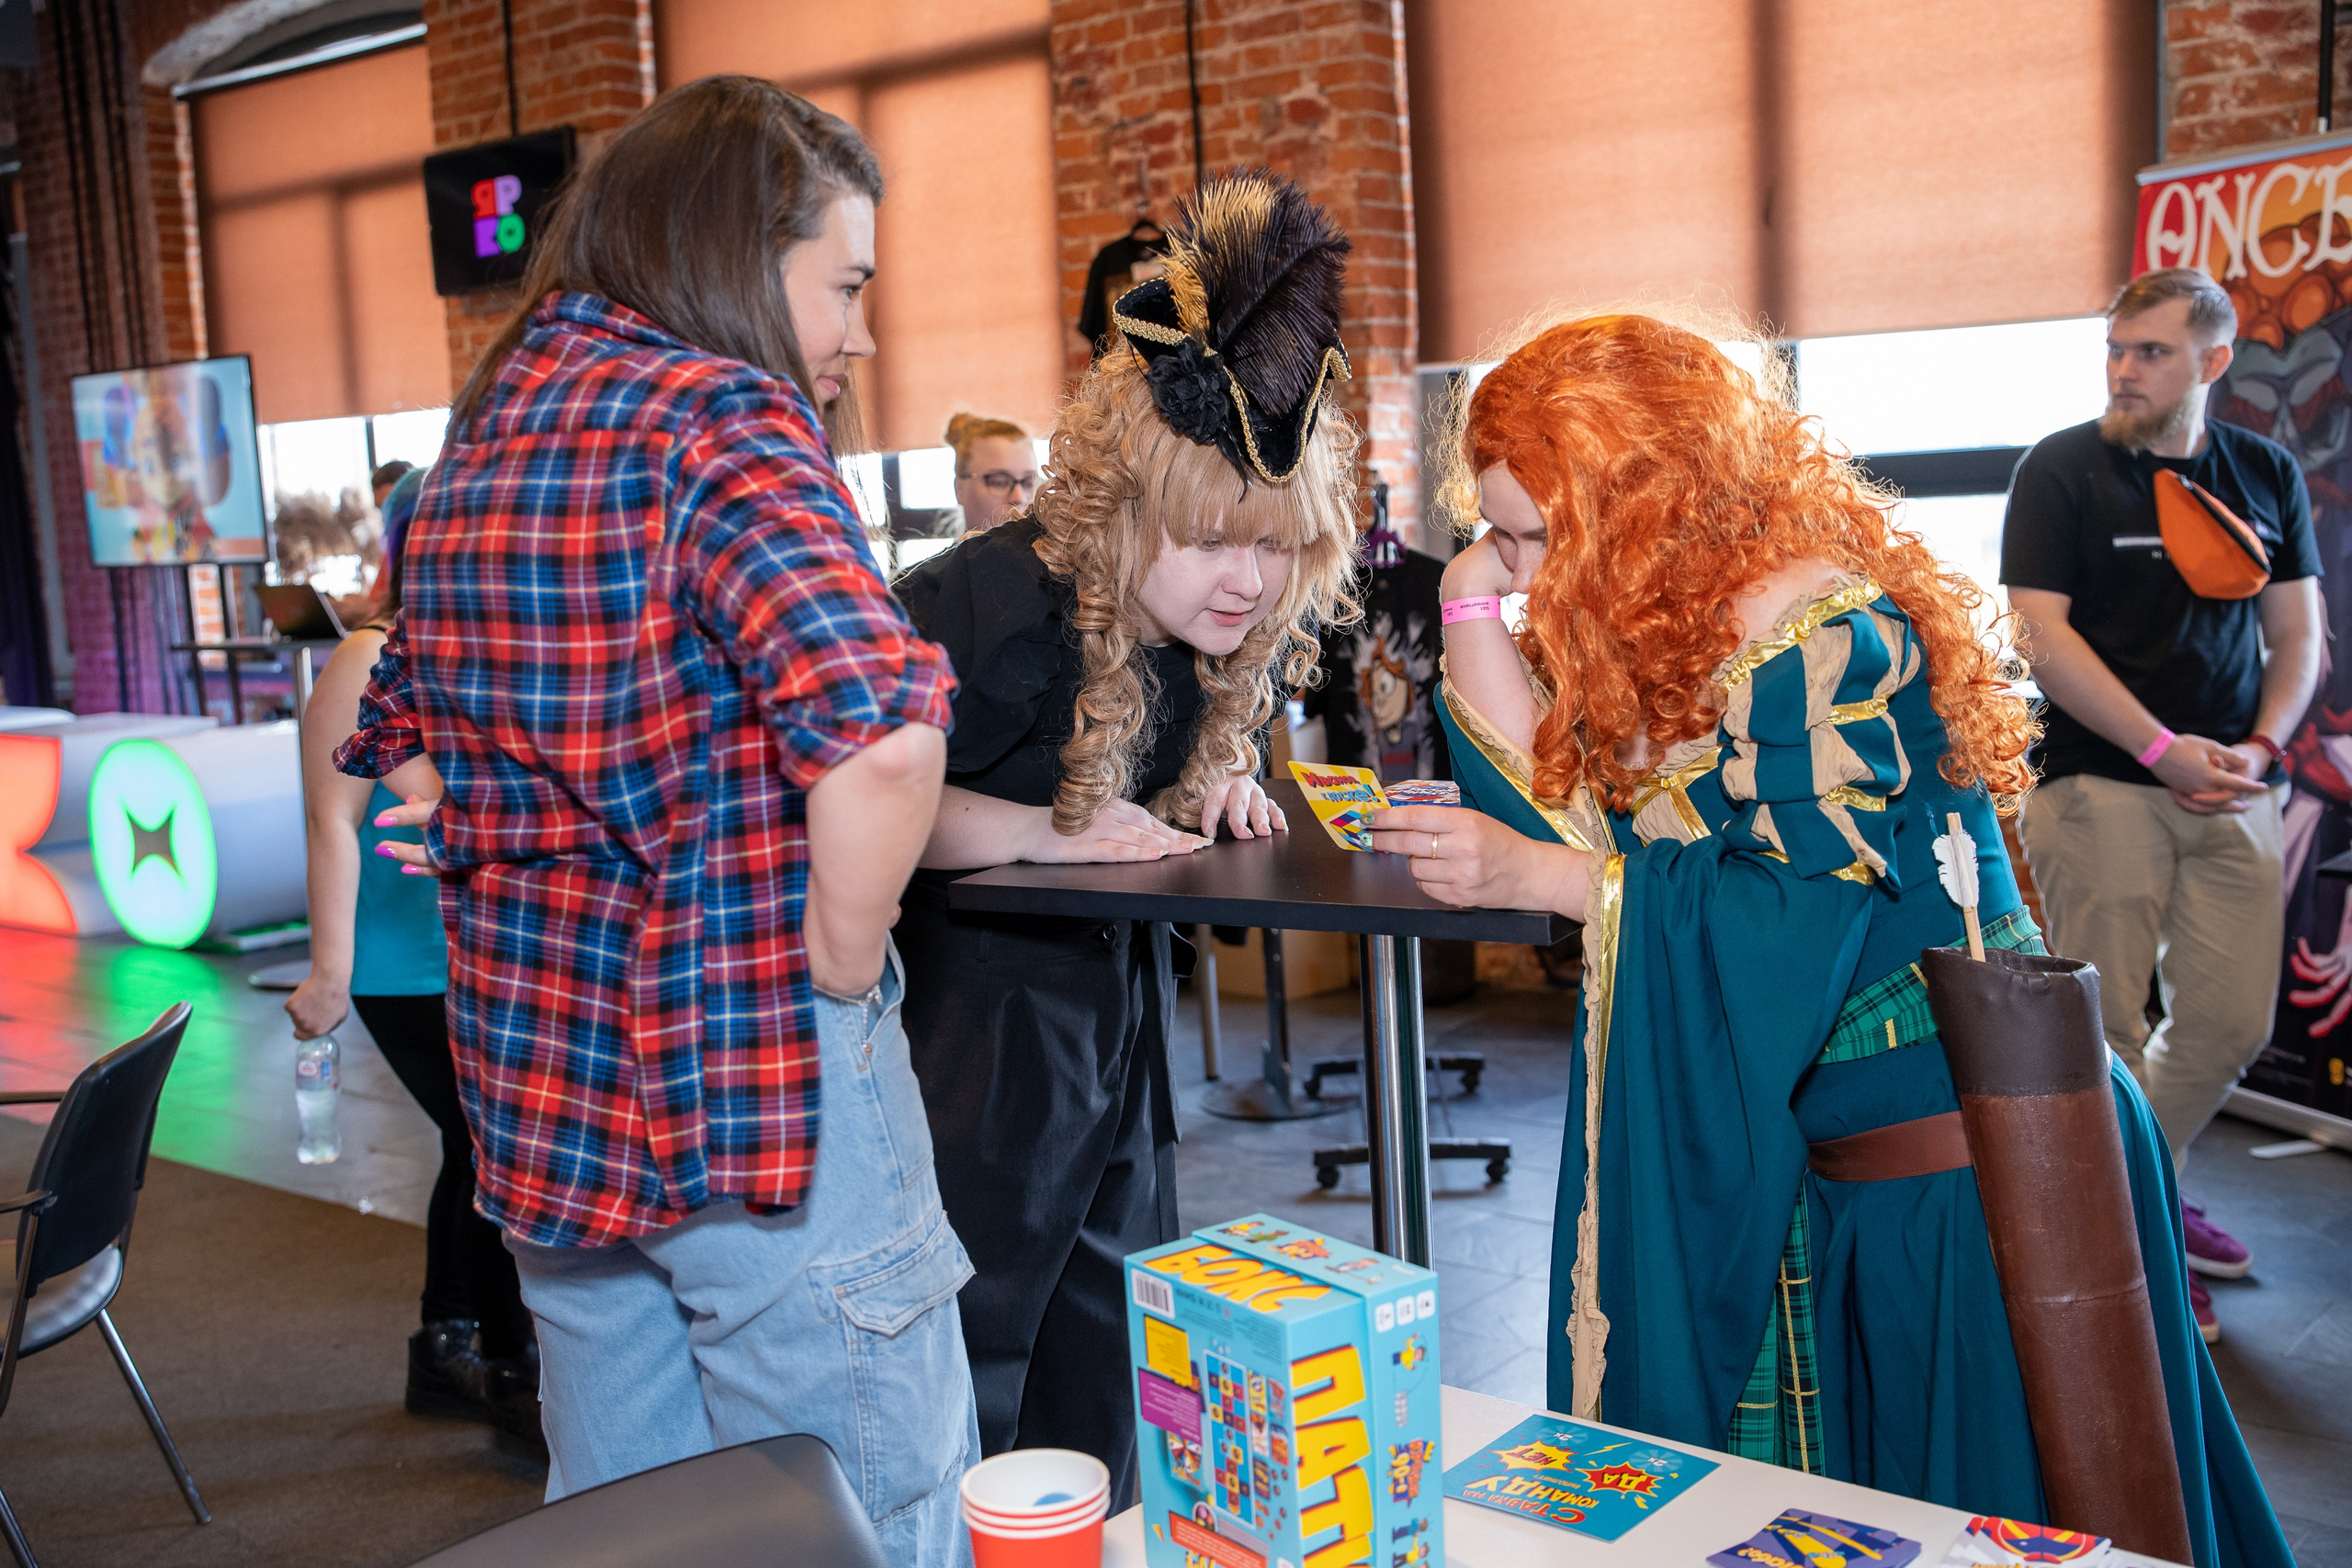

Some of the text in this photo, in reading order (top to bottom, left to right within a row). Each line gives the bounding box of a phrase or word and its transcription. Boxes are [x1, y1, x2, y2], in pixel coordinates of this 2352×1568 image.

[1142, 1244, 1331, 1314] БОКС
[1507, 1447, 1558, 1467] НЕТ
[1464, 1473, 1600, 1509] КОМАНДУ
[1601, 1472, 1647, 1493] ДА
[1463, 1488, 1587, 1524] СТАВКА НА
